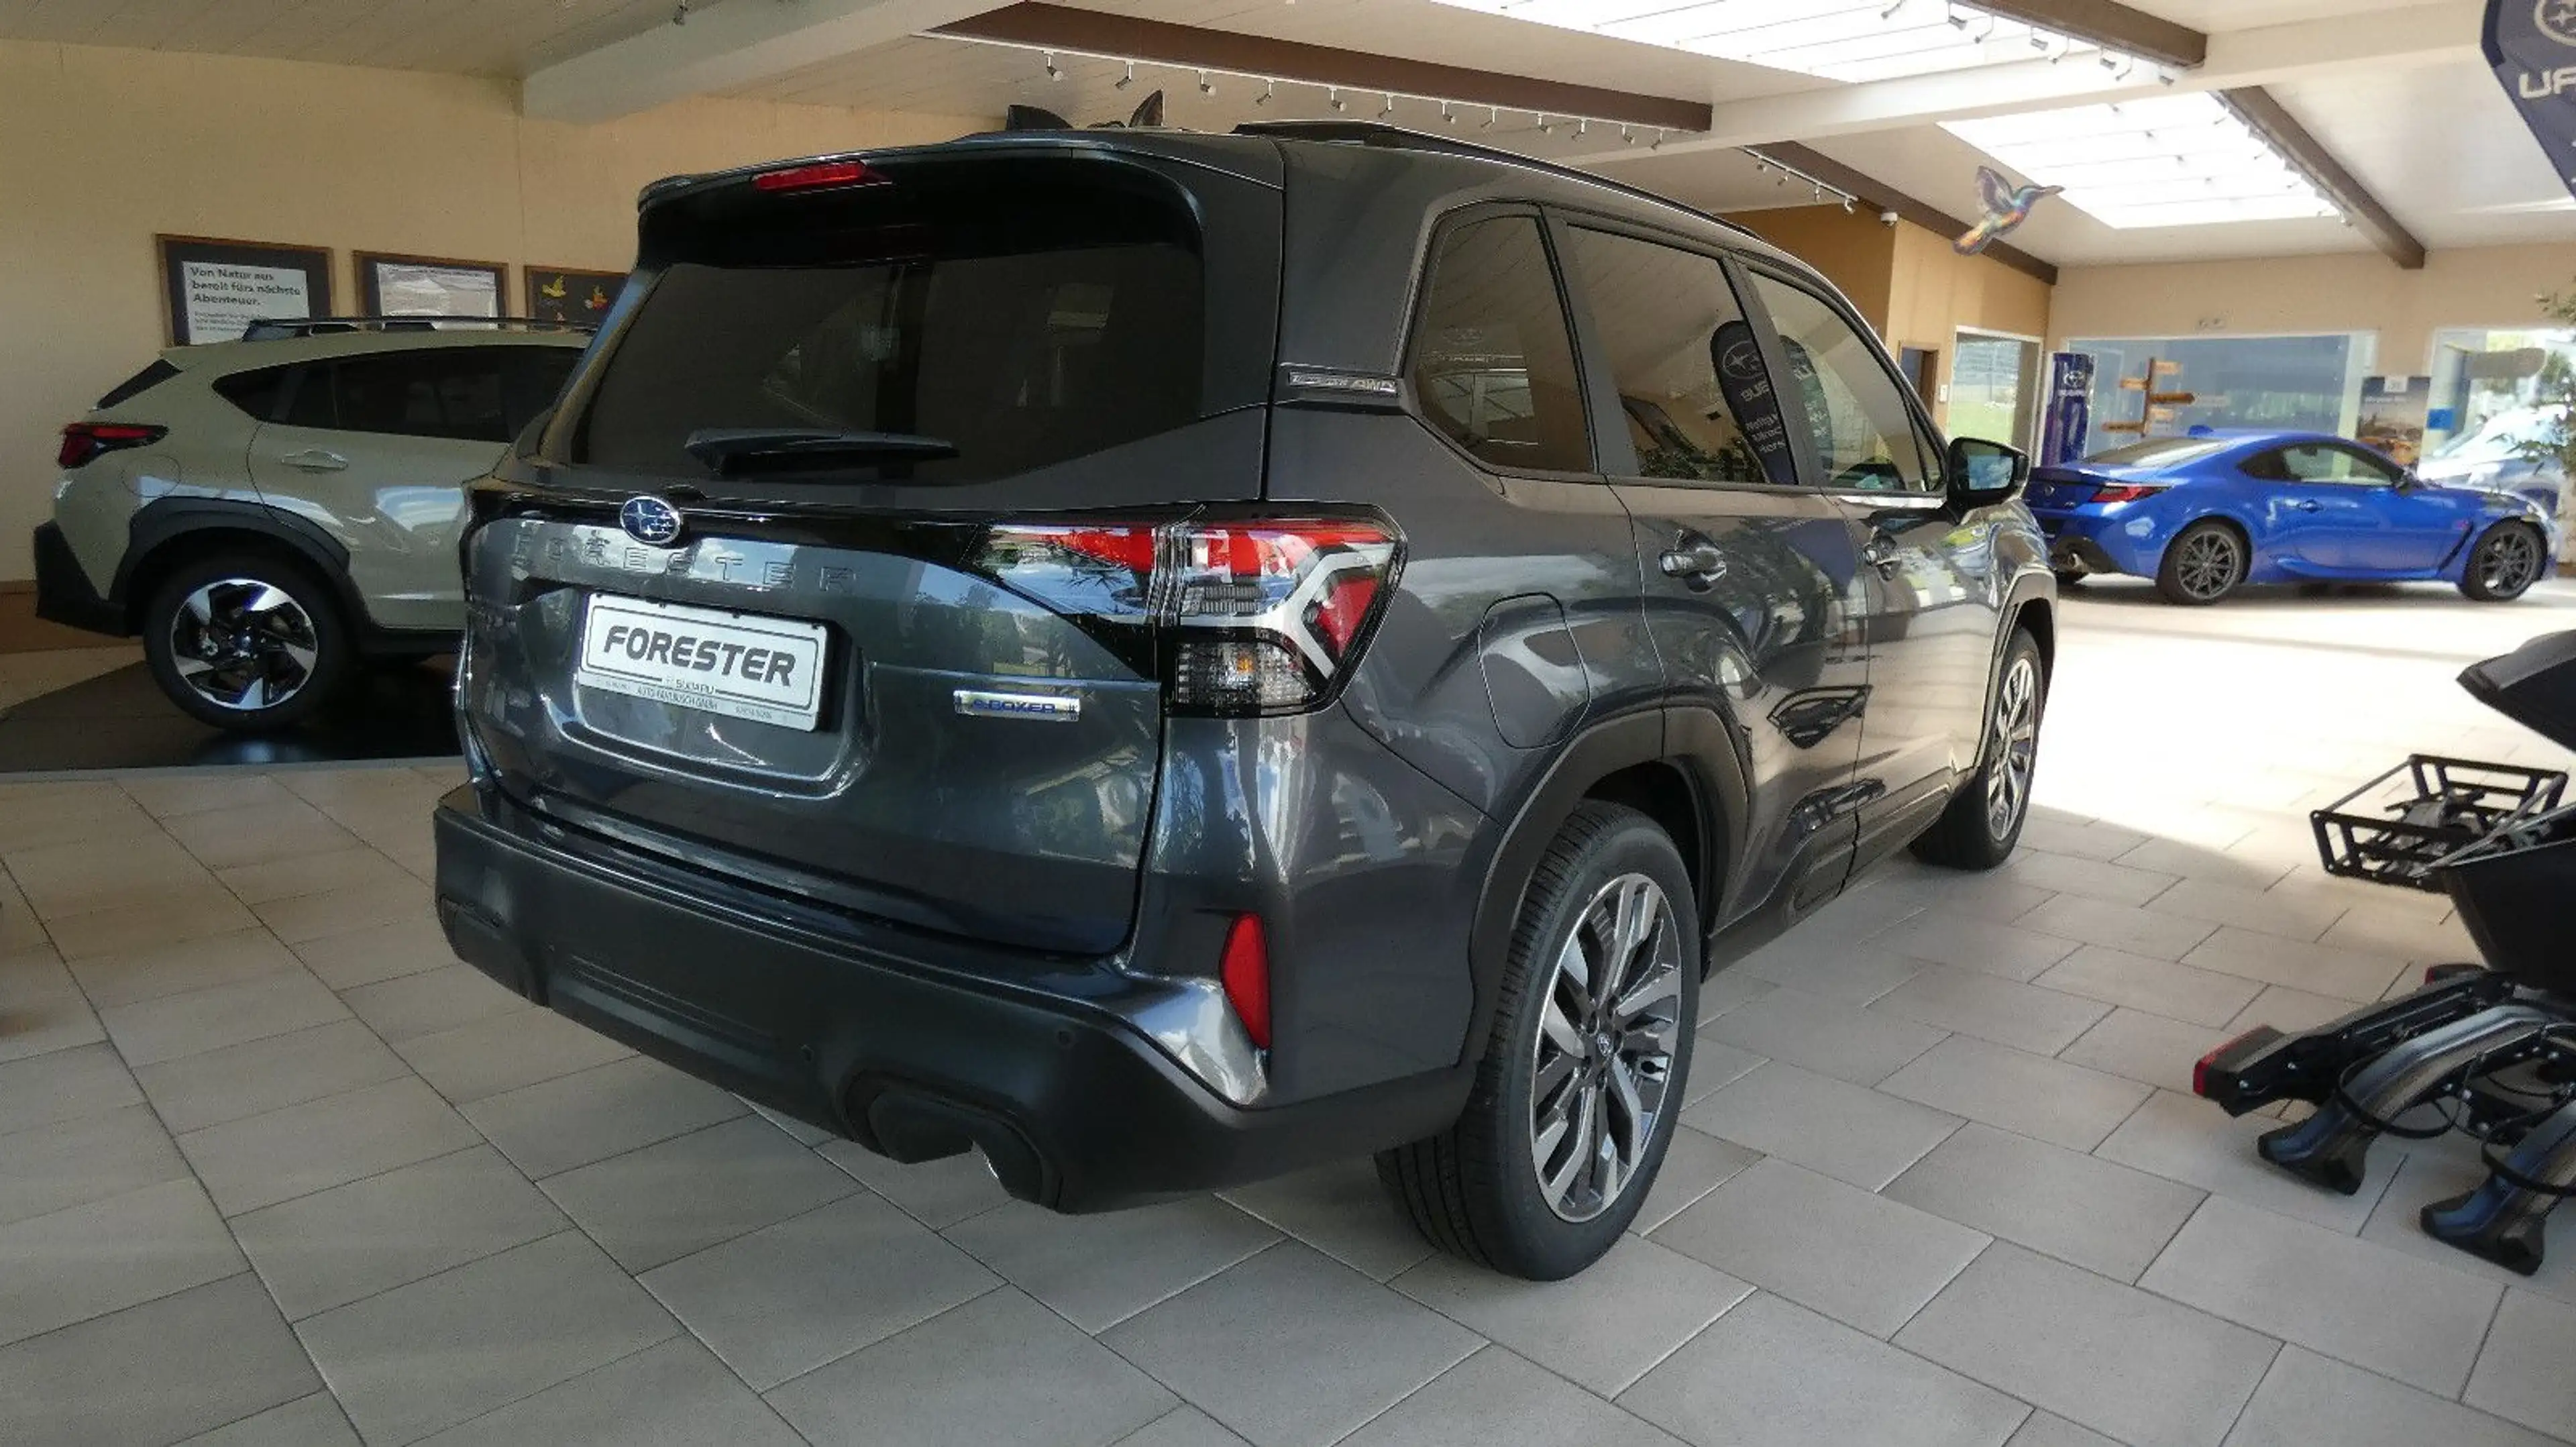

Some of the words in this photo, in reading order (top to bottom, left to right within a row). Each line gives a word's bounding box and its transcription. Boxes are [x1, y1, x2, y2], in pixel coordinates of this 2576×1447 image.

[190, 267, 215, 277] Von
[219, 268, 252, 278] Natur
[254, 272, 274, 280] aus
[192, 280, 229, 290] bereit
[193, 293, 261, 305] Abenteuer.
[604, 625, 796, 686] FORESTER
